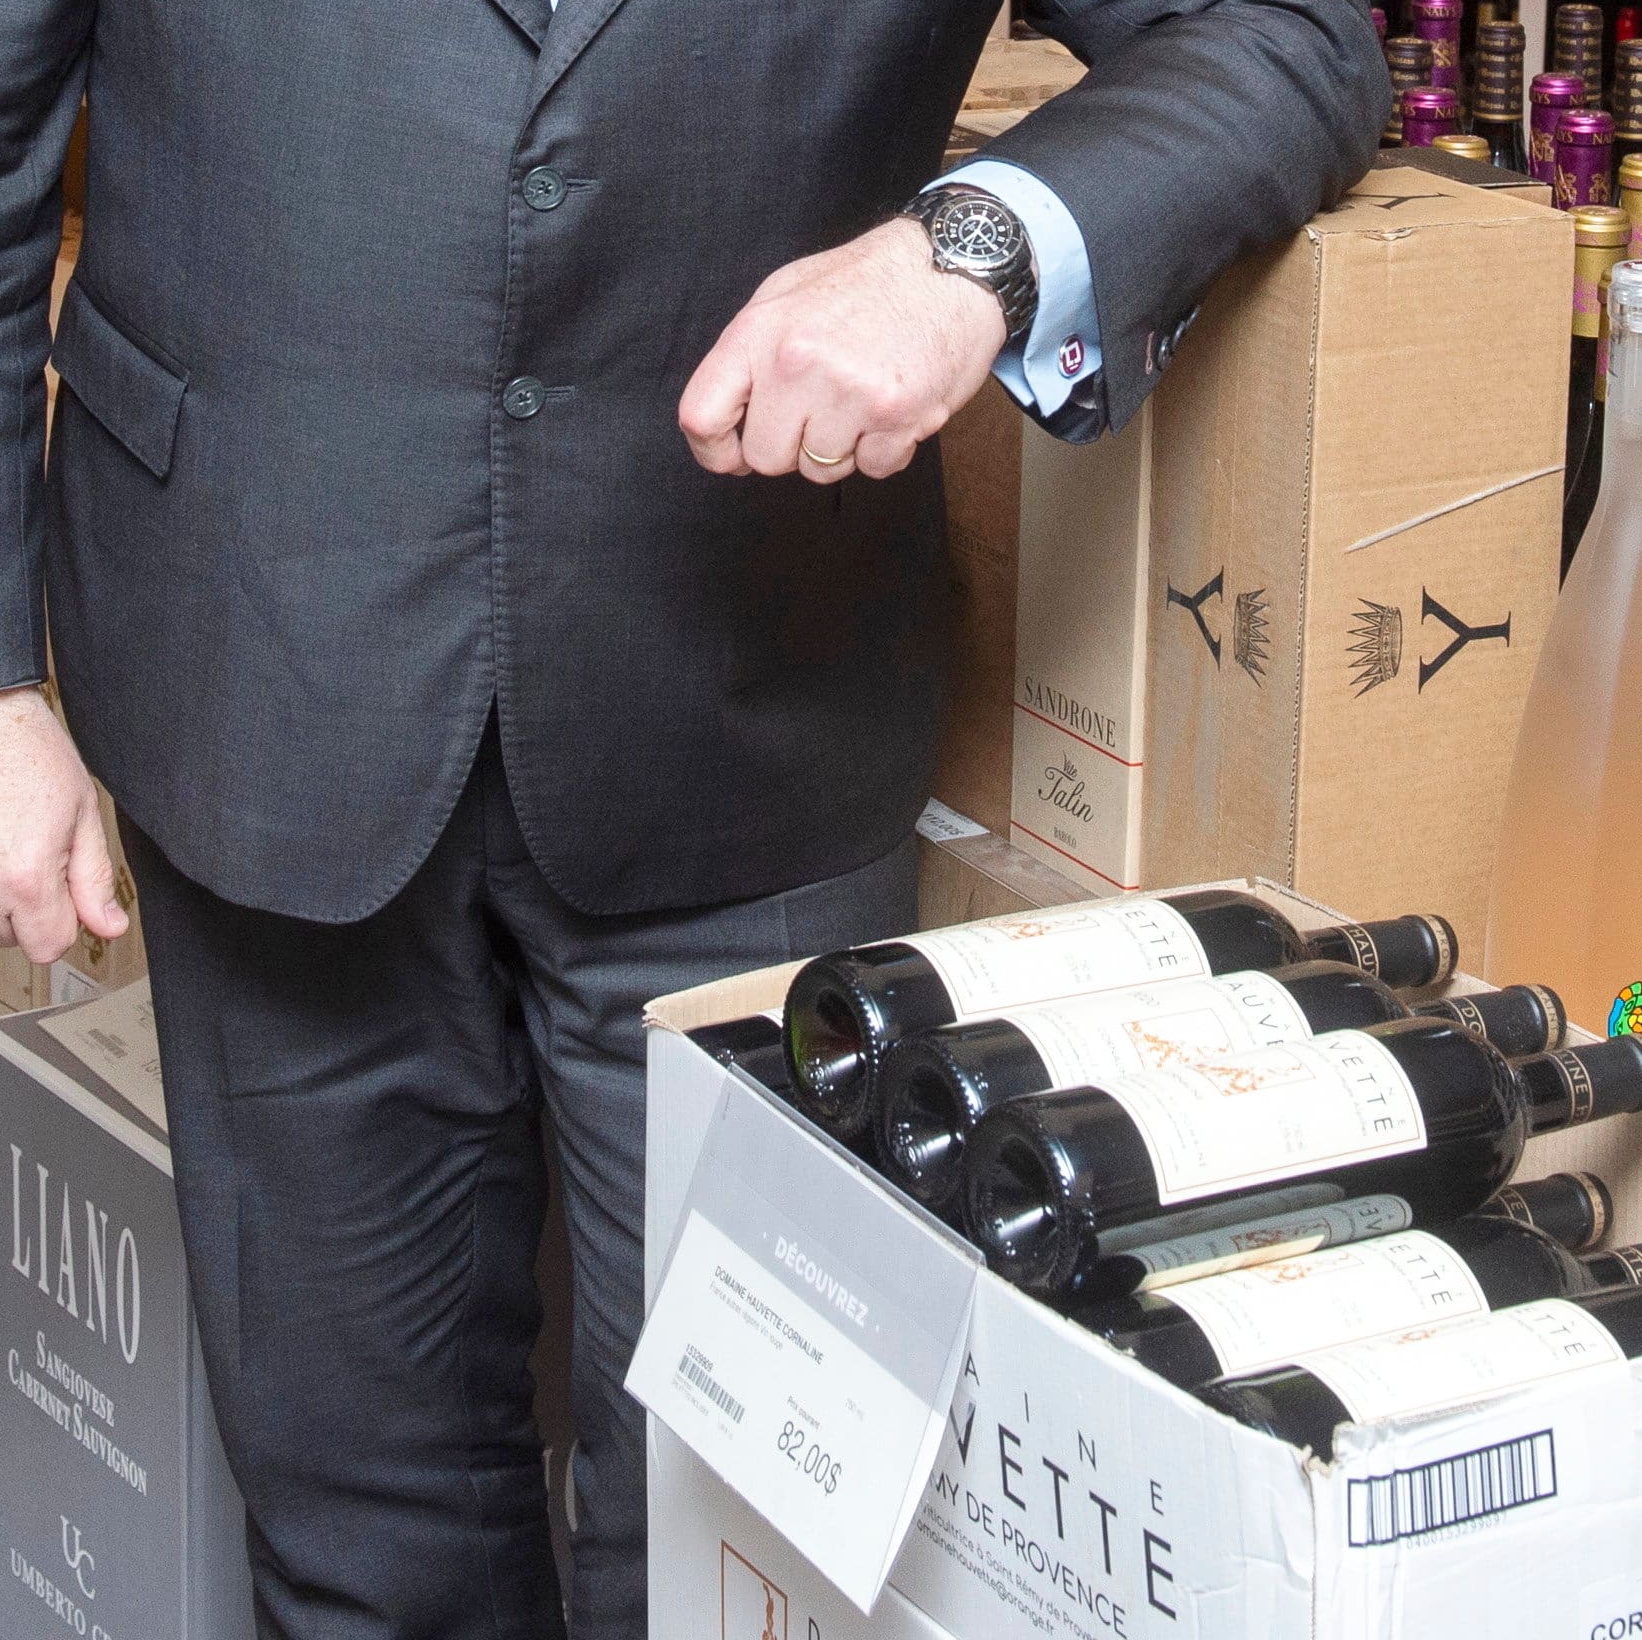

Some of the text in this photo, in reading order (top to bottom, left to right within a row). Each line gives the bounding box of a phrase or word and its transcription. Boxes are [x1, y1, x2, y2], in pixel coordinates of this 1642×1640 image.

[1418, 585, 1512, 694] Y
[1024, 675, 1117, 749] SANDRONE
[9, 1142, 142, 1365] LIANO
[774, 1234, 870, 1329] DÉCOUVREZ
[714, 1264, 825, 1366] DOMAINE HAUVETTE CORNALINE
[7, 1348, 148, 1497] CABERNET SAUVIGNON
[35, 1329, 115, 1428] SANGIOVESE
[777, 1420, 843, 1496] 82,00$
[949, 1402, 1177, 1622] VETTE
[9, 1547, 87, 1637] UMBERTO
[916, 1519, 1055, 1636] omainehauvette@orange.fr
[965, 1490, 996, 1538] DE
[1001, 1518, 1128, 1640] PROVENCE
[985, 1550, 1015, 1583] Saint
